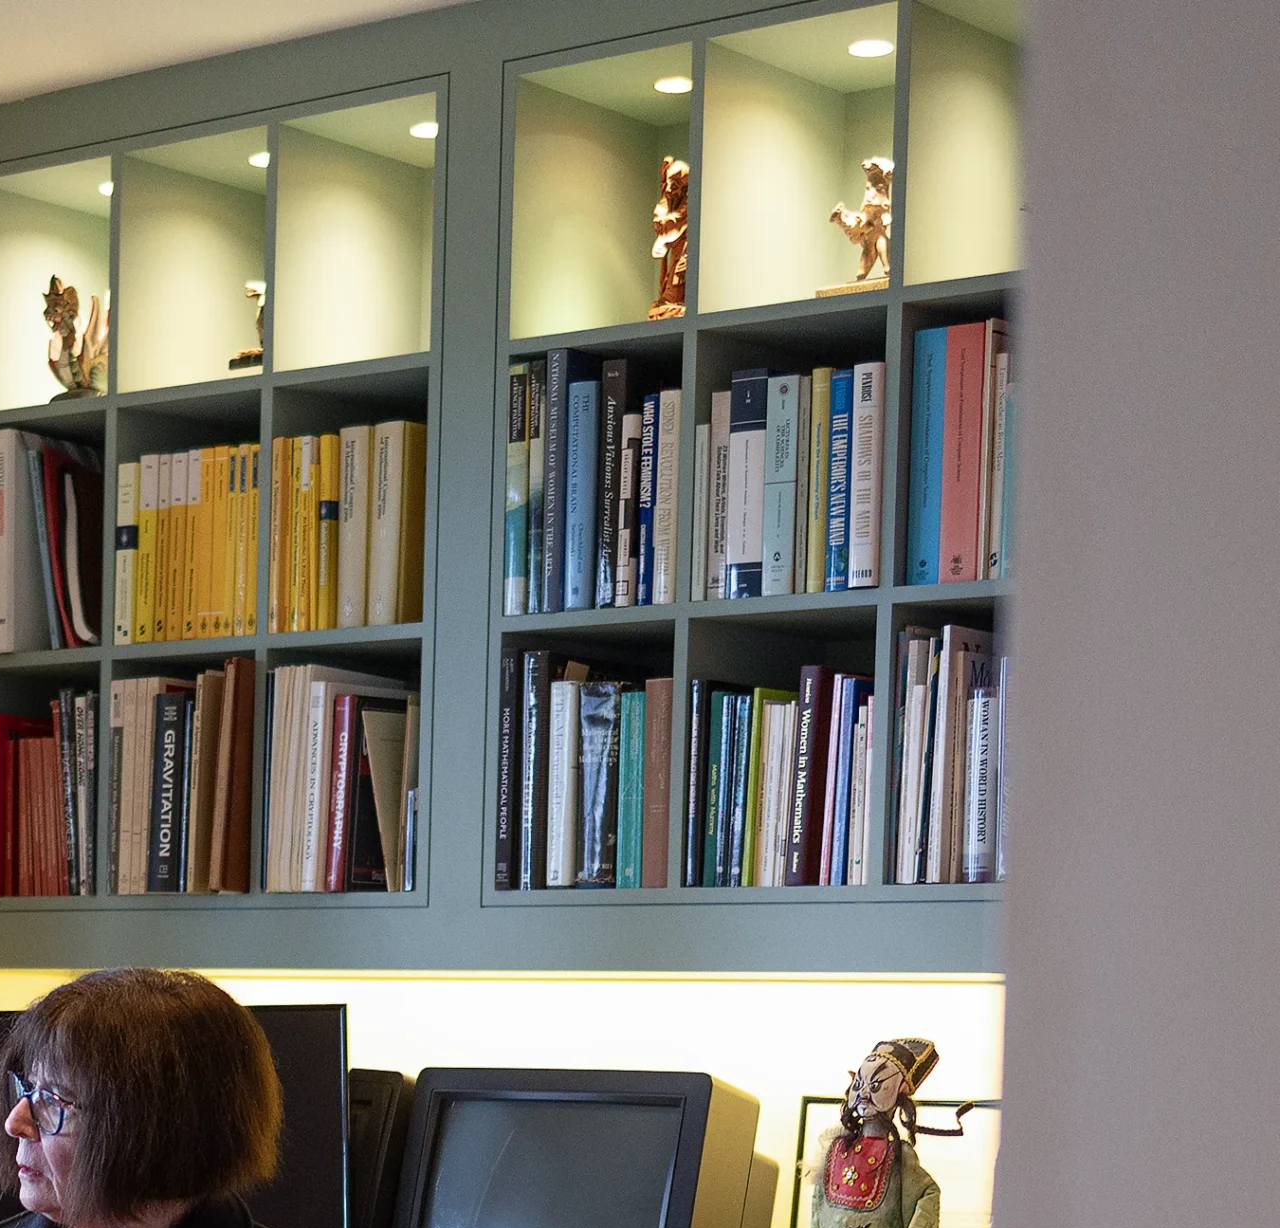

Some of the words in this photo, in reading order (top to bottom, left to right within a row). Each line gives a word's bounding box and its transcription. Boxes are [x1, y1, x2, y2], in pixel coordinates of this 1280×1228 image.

[550, 353, 560, 404] NATIONAL
[861, 372, 873, 403] PENROSE
[582, 395, 590, 413] THE
[642, 401, 654, 424] WHO
[663, 402, 675, 435] STEINEM
[549, 406, 559, 451] MUSEUM
[606, 396, 617, 446] Anxious
[832, 413, 848, 431] THE
[346, 440, 350, 448] of
[380, 436, 384, 445] of
[571, 395, 580, 480] COMPUTATIONAL
[641, 426, 653, 454] STOLE
[858, 415, 873, 465] SHADOWS
[548, 454, 558, 468] OF
[604, 448, 615, 488] Visions:
[659, 442, 674, 504] REVOLUTION
[831, 434, 847, 492] EMPEROR'S
[857, 470, 872, 482] OF
[547, 471, 557, 509] WOMEN
[640, 456, 652, 508] FEMINISM?
[856, 488, 871, 506] THE
[570, 483, 578, 514] BRAIN
[830, 494, 845, 515] NEW
[547, 512, 555, 522] IN
[603, 491, 613, 543] Surrealist
[658, 508, 672, 536] FROM
[829, 518, 845, 546] MIND
[856, 509, 871, 538] MIND
[546, 526, 554, 549] THE
[555, 701, 564, 723] The
[980, 700, 990, 741] WOMAN
[310, 720, 319, 774] ADVANCES
[800, 708, 812, 754] Women
[799, 756, 809, 767] in
[980, 744, 988, 755] IN
[309, 778, 316, 789] IN
[500, 736, 509, 804] MATHEMATICAL
[978, 759, 988, 796] WORLD
[159, 730, 175, 857] GRAVITATION
[332, 732, 348, 850] CRYPTOGRAPHY
[499, 807, 507, 838] PEOPLE
[708, 807, 716, 835] Mummy
[792, 771, 808, 844] Mathematics
[977, 799, 986, 844] HISTORY
[65, 808, 75, 860] IMAGES
[305, 793, 315, 860] CRYPTOLOGY
